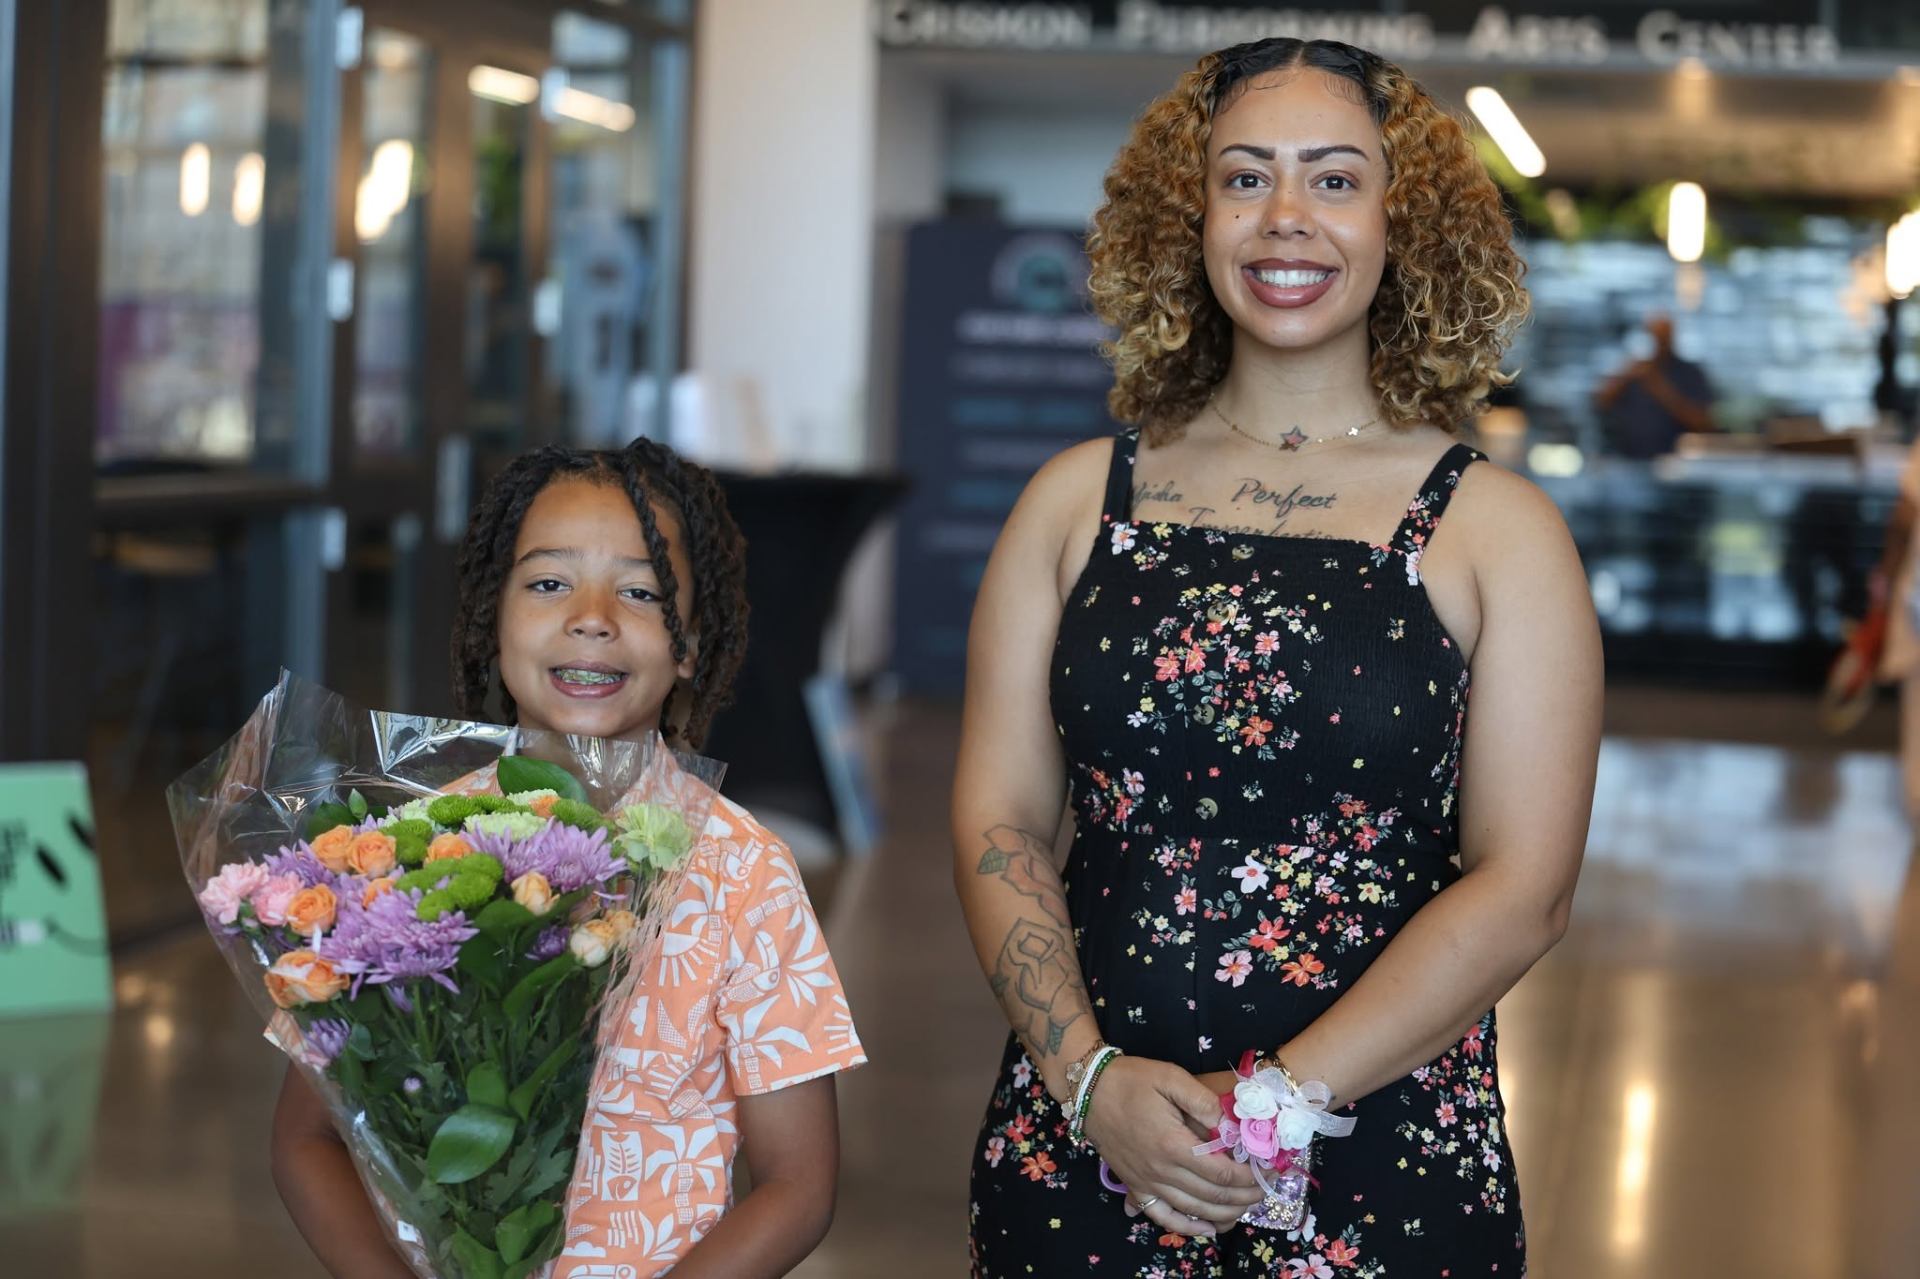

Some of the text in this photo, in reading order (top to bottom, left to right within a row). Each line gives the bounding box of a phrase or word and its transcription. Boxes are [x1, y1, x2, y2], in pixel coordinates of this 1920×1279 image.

[1468, 5, 1606, 63] ARTS
[1637, 9, 1838, 67] CENTER
[1231, 477, 1337, 518] Perfect
